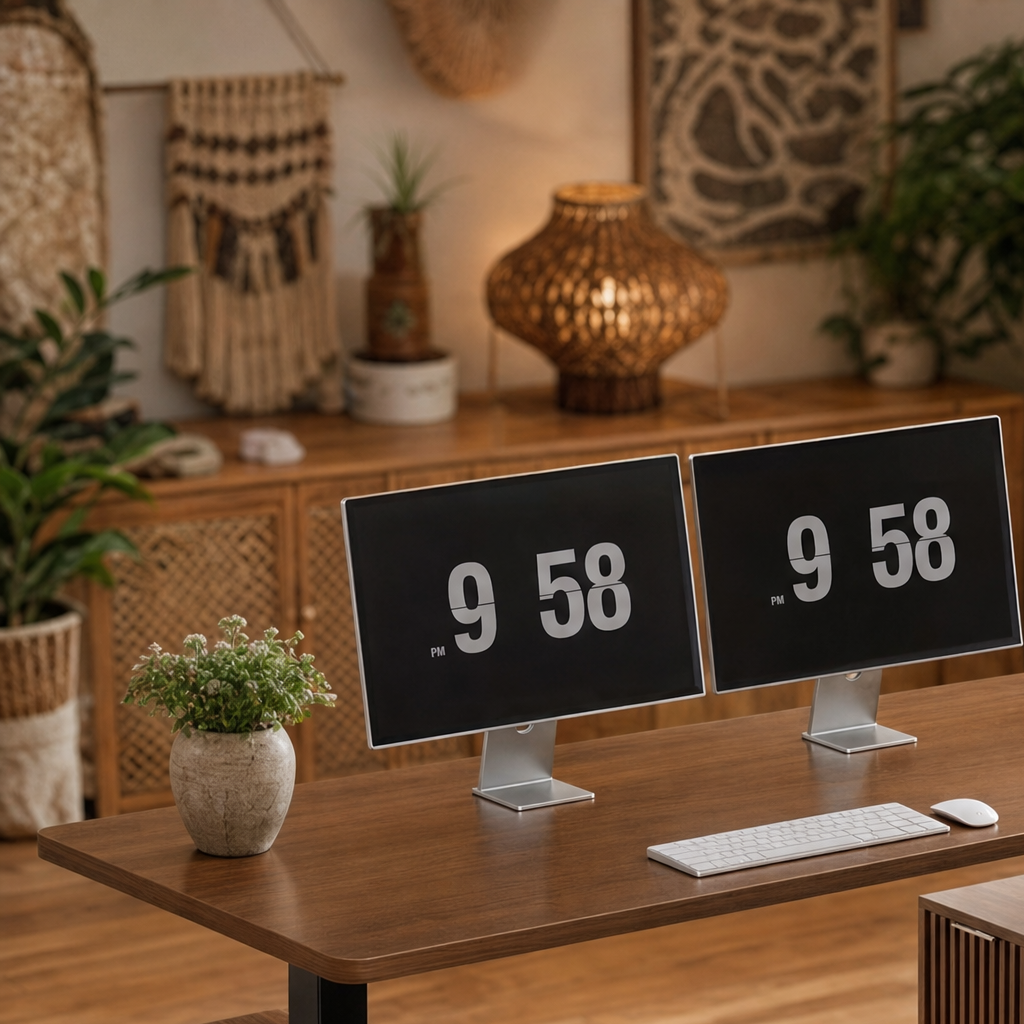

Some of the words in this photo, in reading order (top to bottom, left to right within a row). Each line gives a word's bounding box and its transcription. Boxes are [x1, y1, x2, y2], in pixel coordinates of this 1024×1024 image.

[787, 515, 833, 603] 9
[869, 496, 957, 589] 58
[447, 561, 497, 654] 9
[535, 541, 632, 639] 58
[770, 594, 785, 606] PM
[430, 645, 446, 658] PM
